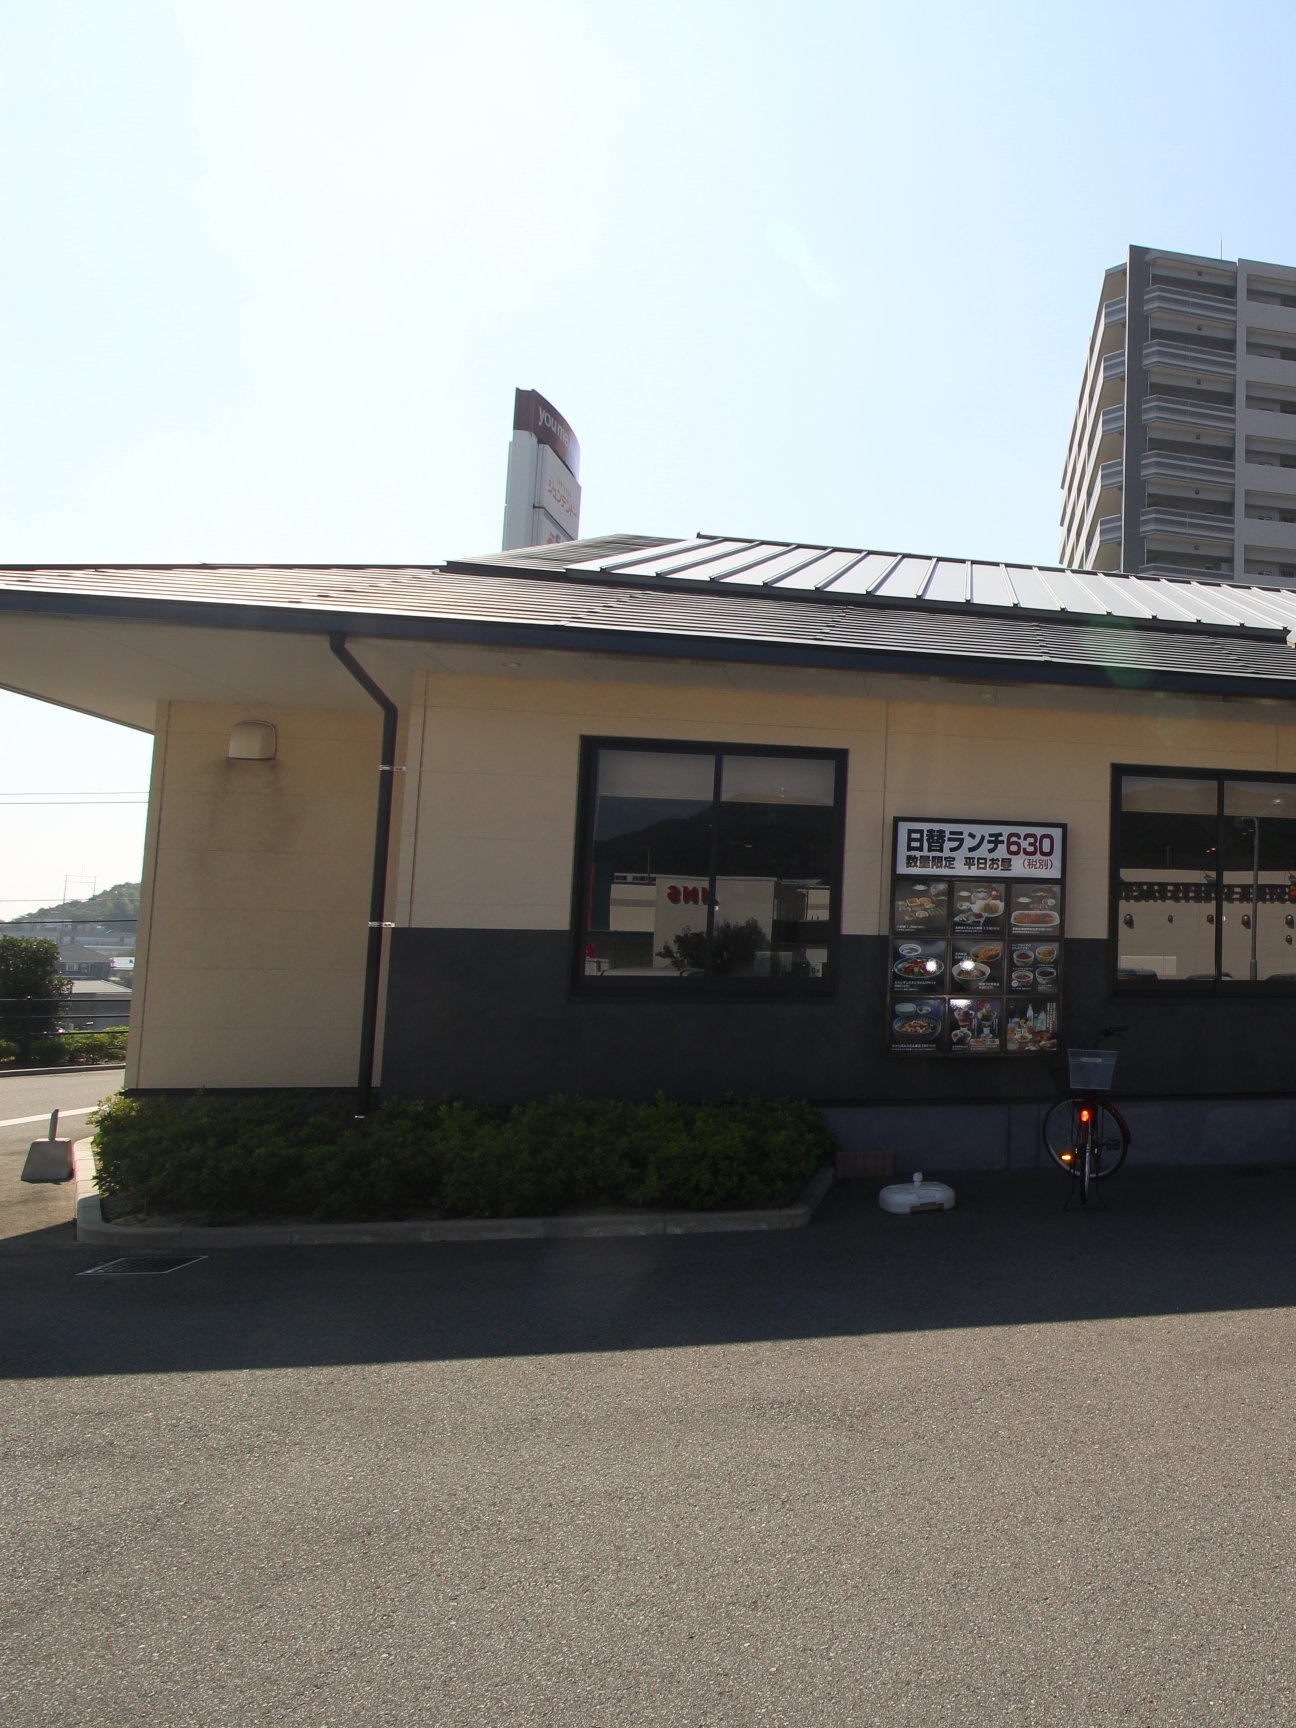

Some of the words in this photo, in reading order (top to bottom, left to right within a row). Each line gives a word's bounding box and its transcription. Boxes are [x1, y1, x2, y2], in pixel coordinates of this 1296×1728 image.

[905, 855, 956, 870] 数量限定
[963, 857, 1013, 871] 平日お昼
